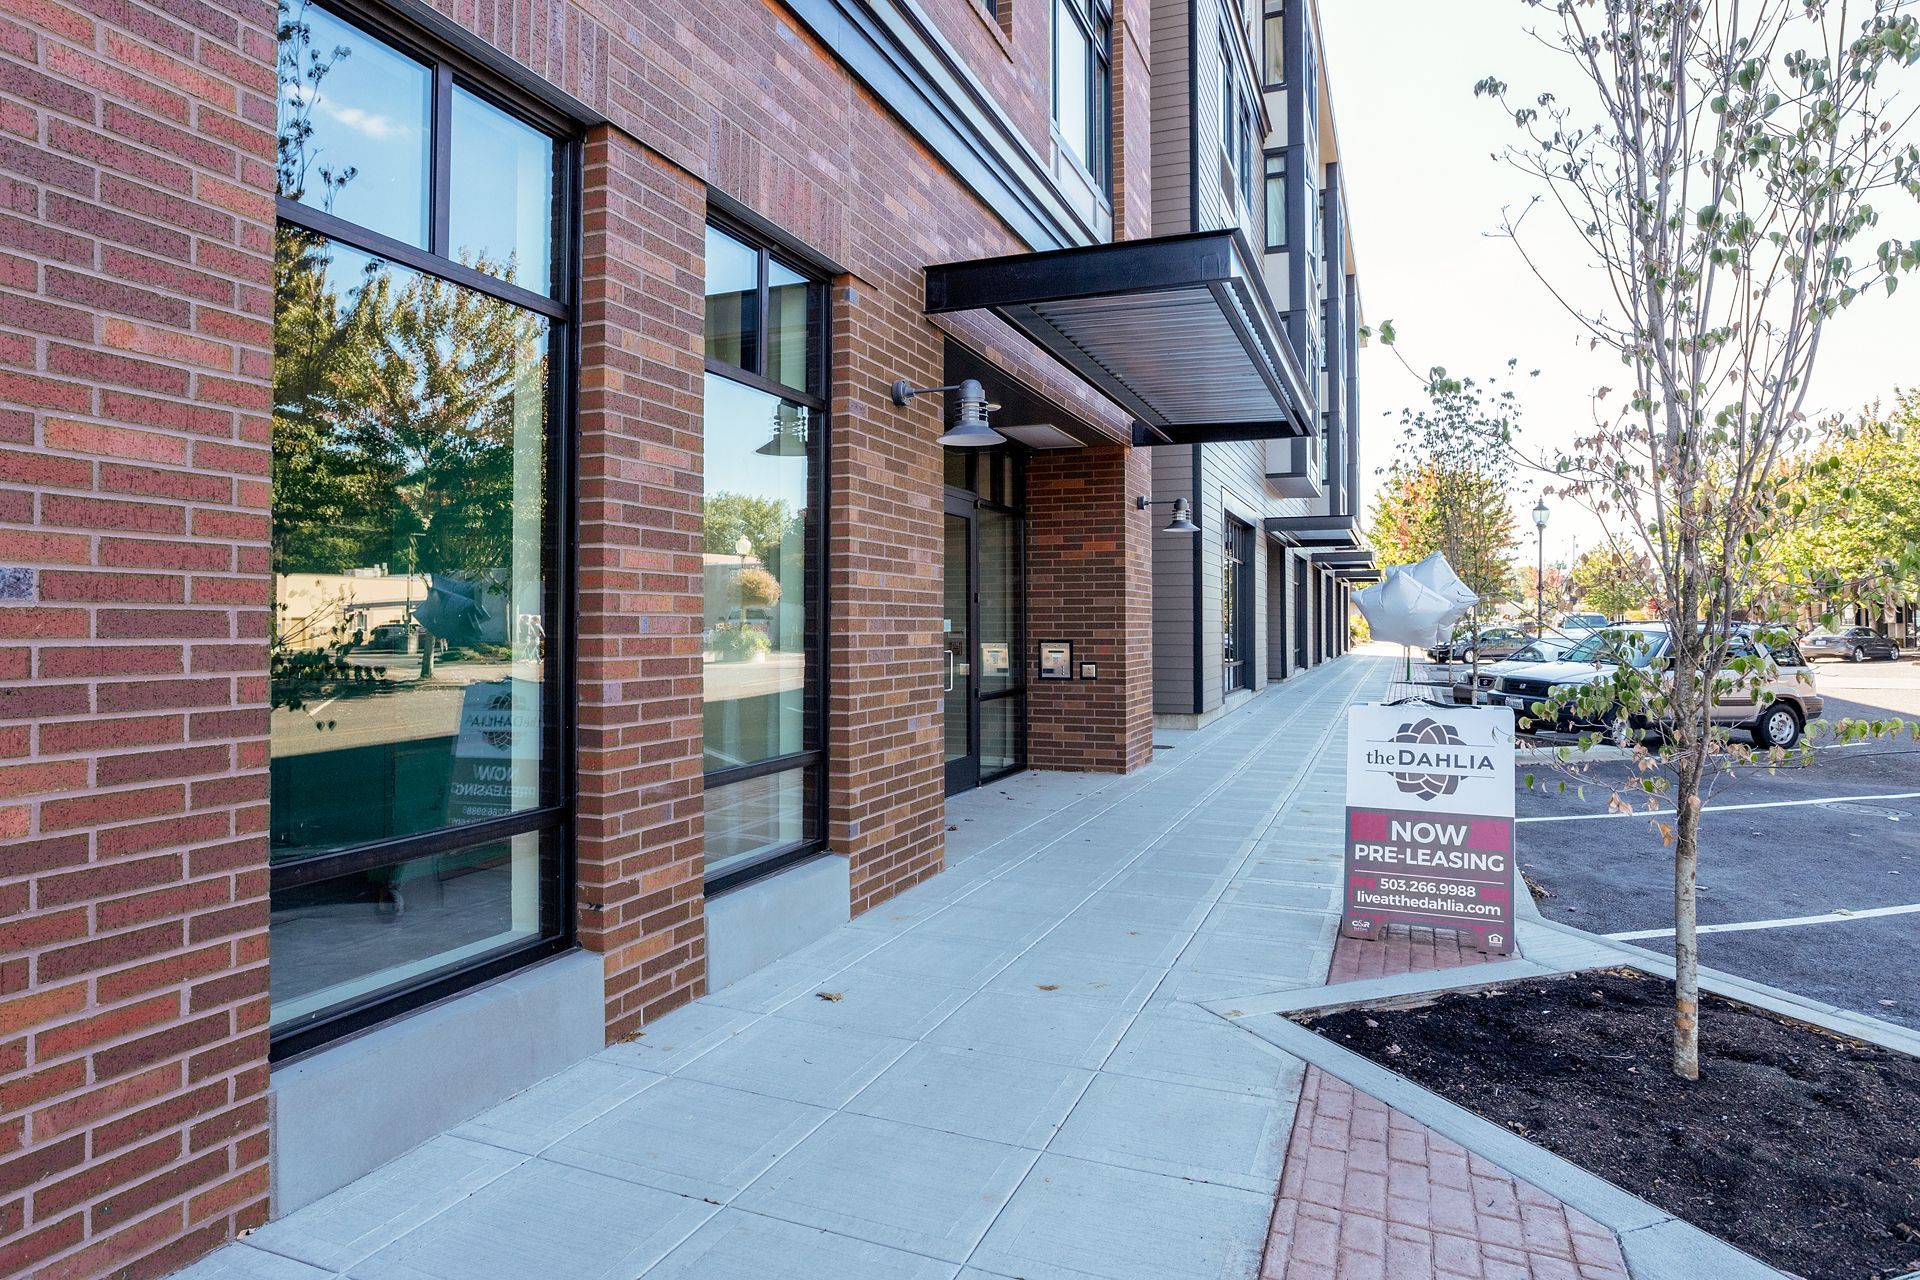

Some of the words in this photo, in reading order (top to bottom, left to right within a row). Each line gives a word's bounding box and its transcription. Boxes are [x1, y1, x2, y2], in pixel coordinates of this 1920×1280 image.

[1398, 749, 1495, 771] DAHLIA
[1391, 820, 1468, 846] NOW
[1354, 843, 1505, 872] PRE-LEASING
[1379, 877, 1477, 898] 503.266.9988
[1356, 890, 1501, 916] liveatthedahlia.com
[1351, 919, 1370, 929] C&R
